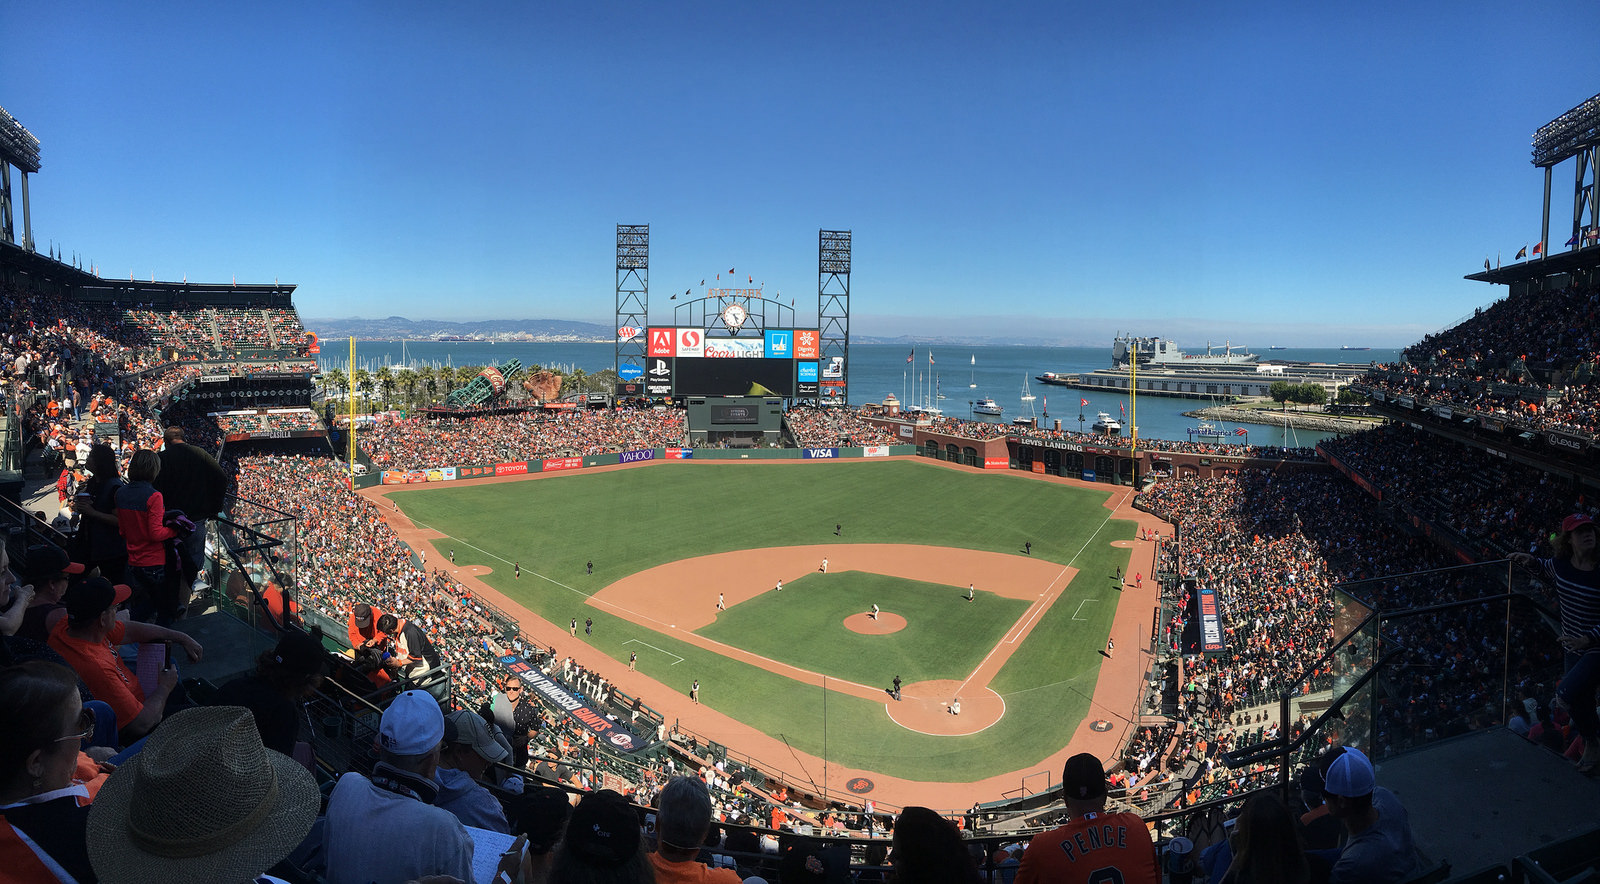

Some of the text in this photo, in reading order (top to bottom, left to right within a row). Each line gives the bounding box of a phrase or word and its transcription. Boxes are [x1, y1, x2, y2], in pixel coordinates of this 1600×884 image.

[707, 288, 762, 299] AT&T PARK
[705, 346, 764, 358] Coors LIGHT
[269, 431, 291, 439] CASILLA
[1208, 428, 1232, 436] America
[1045, 441, 1083, 452] LANDING
[1556, 438, 1581, 450] LEXUS
[621, 449, 653, 462] YAHOO!
[809, 448, 833, 458] VISA
[504, 464, 527, 472] TOYOTA
[520, 670, 583, 711] SAN FRANCISCO
[572, 707, 613, 732] GIANTS
[1059, 825, 1127, 862] PENCE
